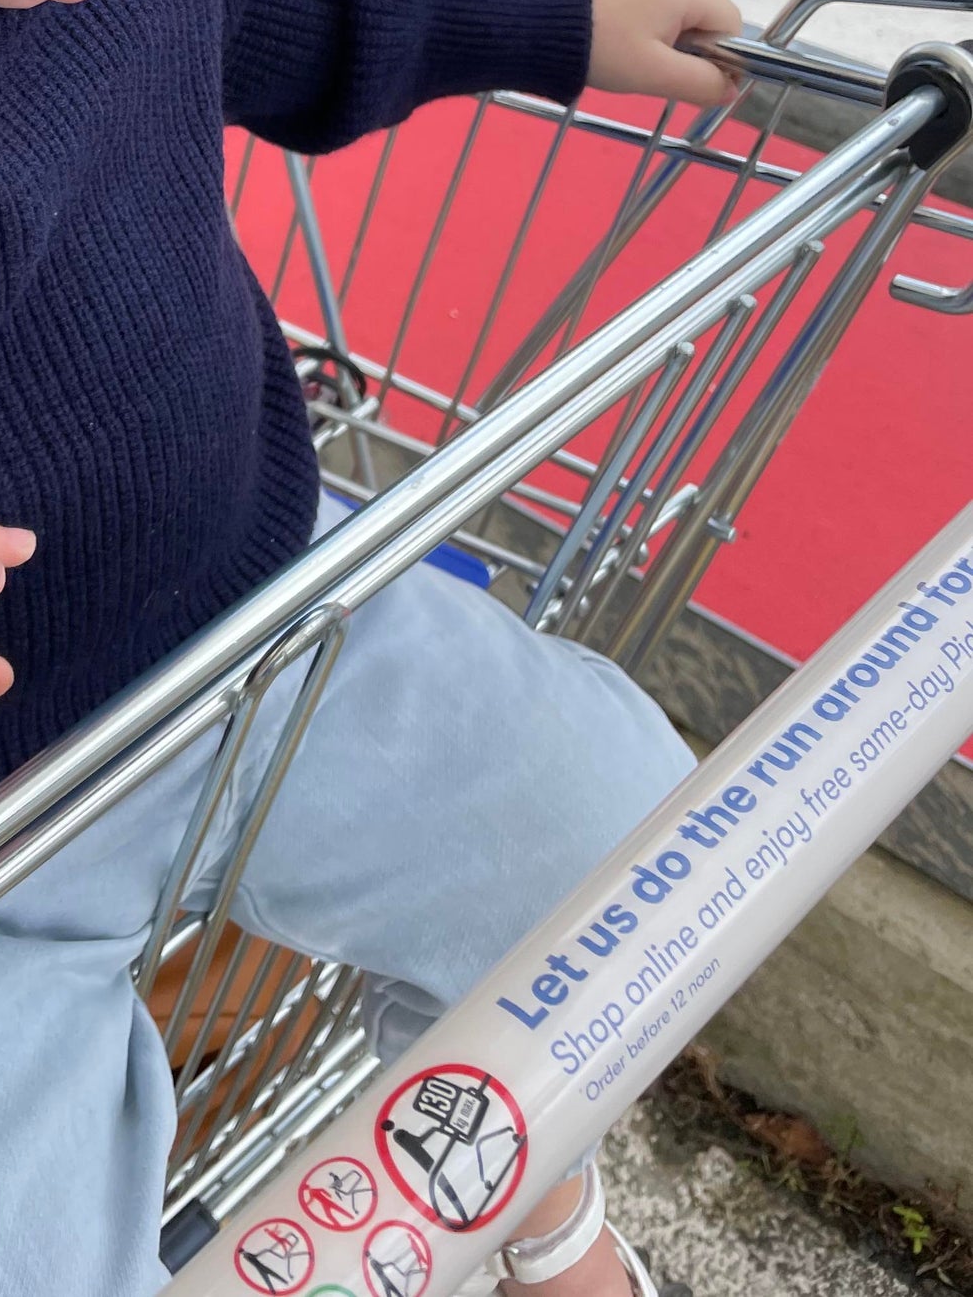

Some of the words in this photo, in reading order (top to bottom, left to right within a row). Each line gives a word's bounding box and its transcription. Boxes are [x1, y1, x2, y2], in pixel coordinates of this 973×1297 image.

[495, 953, 590, 1031] Let
[576, 903, 639, 958] us
[629, 850, 692, 905] do
[677, 784, 757, 849] the
[746, 722, 823, 788] run
[812, 601, 939, 722] around
[916, 556, 973, 607] for
[550, 1002, 625, 1076] Shop
[624, 925, 700, 1007] online
[697, 866, 747, 930] and
[744, 811, 813, 881] enjoy
[800, 766, 852, 817] free
[849, 664, 955, 772] same-day
[939, 620, 973, 671] Pic
[418, 1079, 457, 1119] 130
[625, 1010, 671, 1059] before
[670, 989, 688, 1013] 12
[688, 958, 721, 998] noon
